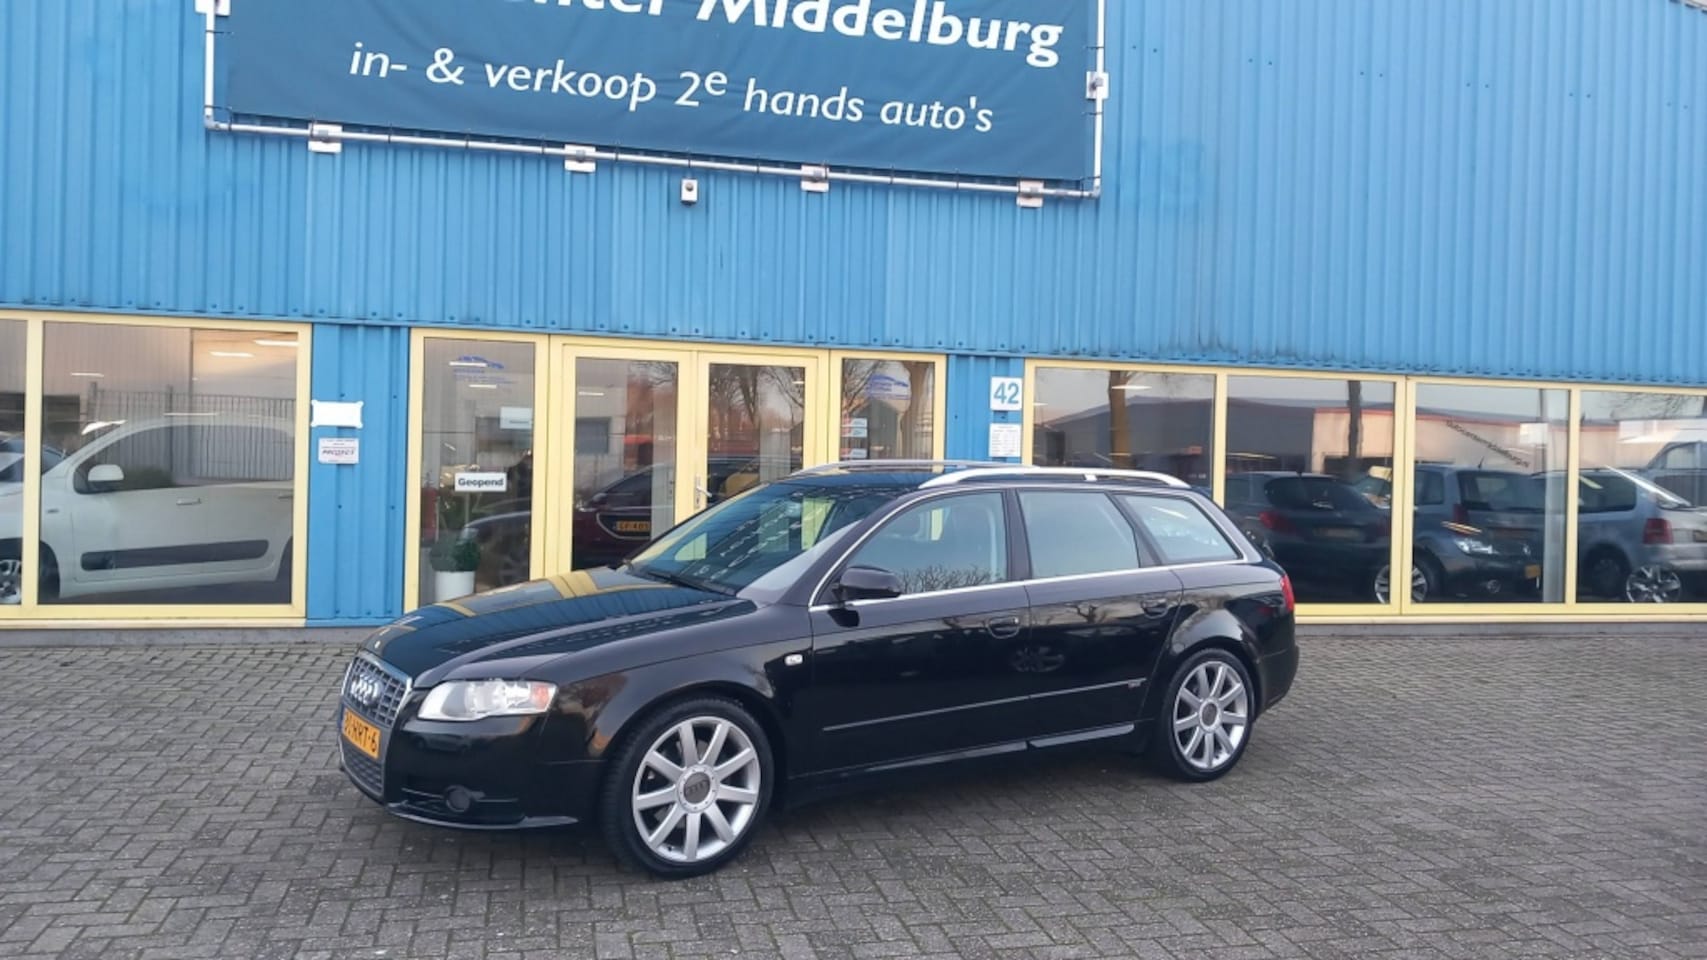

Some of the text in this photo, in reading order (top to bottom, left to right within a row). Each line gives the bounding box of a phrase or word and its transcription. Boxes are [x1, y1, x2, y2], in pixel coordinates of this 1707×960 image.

[696, 0, 1063, 68] Middelburg
[350, 42, 407, 78] in-
[426, 47, 464, 85] &
[485, 59, 656, 112] verkoop
[744, 78, 864, 122] hands
[880, 96, 993, 132] auto's
[993, 381, 1020, 405] 42
[458, 477, 504, 489] Geopend
